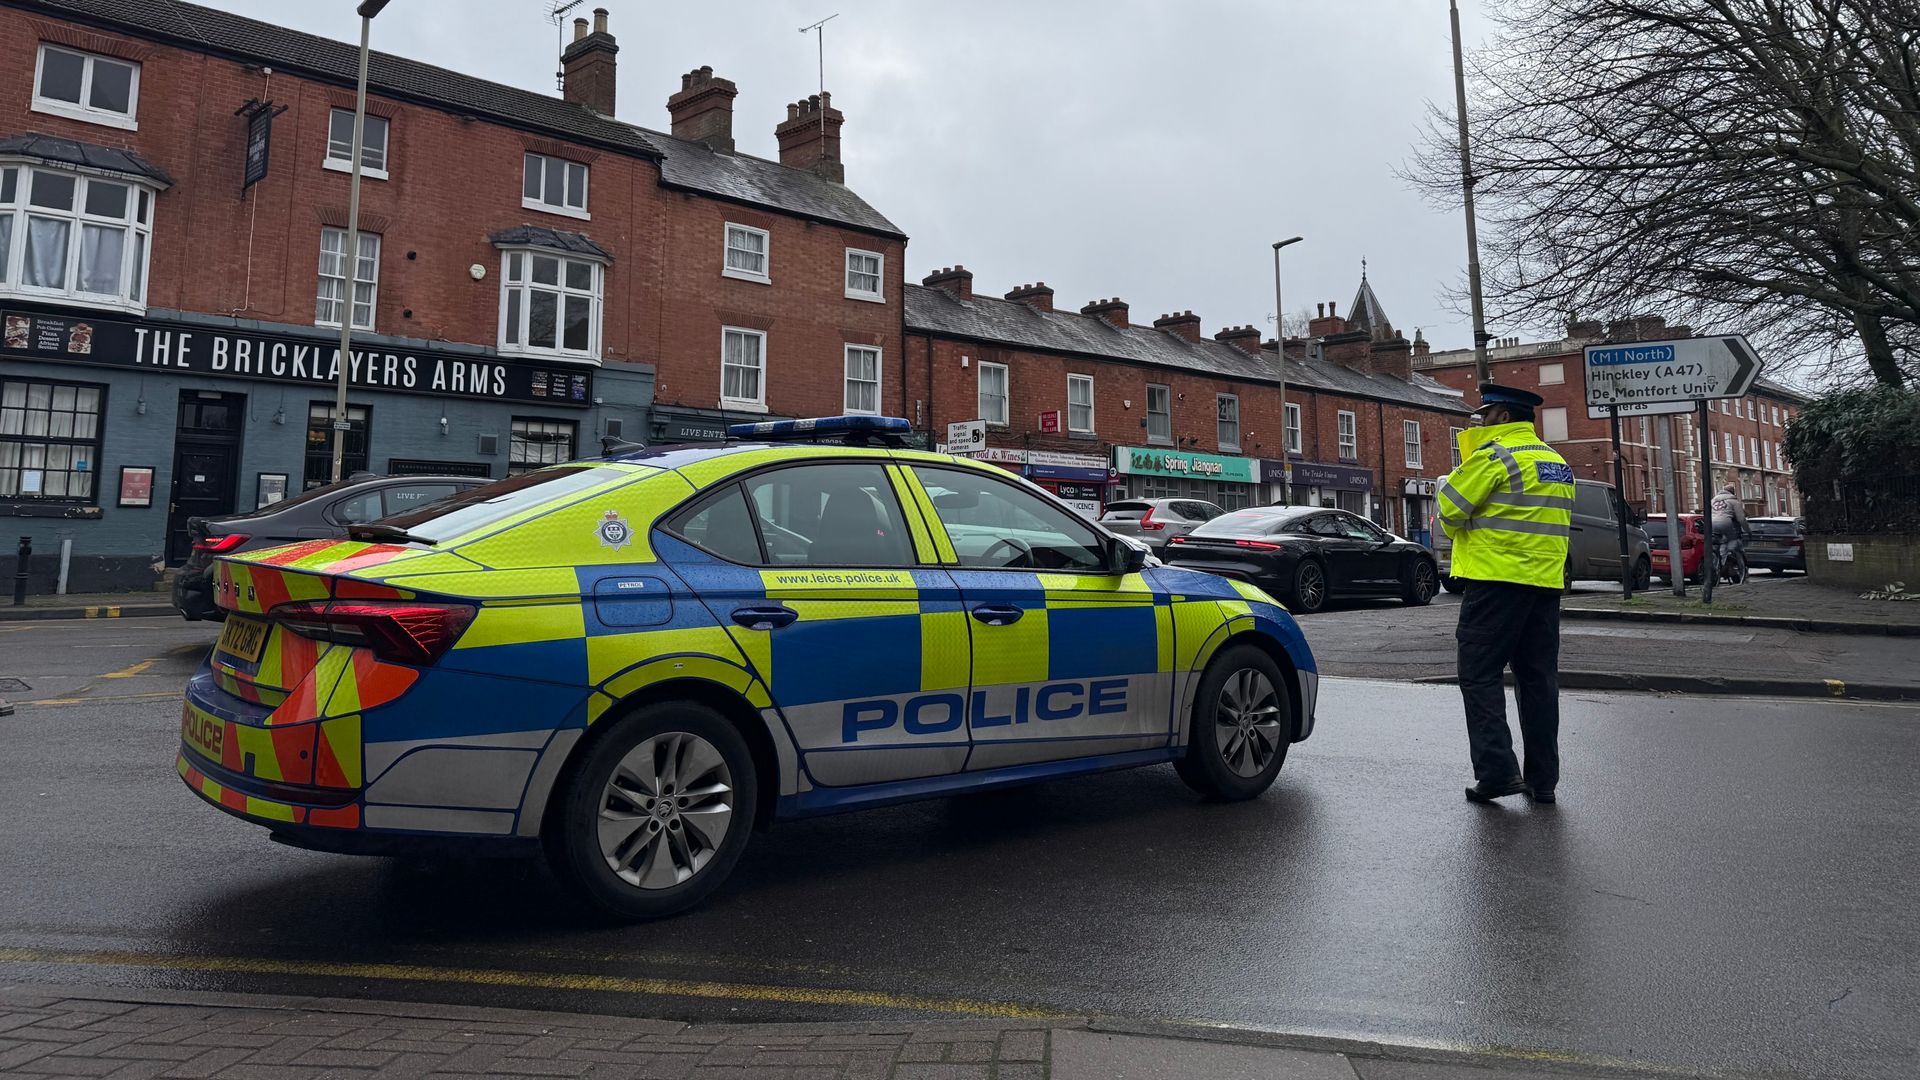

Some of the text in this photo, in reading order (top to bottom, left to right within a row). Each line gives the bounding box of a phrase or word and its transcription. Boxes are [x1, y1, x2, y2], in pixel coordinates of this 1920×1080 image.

[134, 328, 506, 395] THE BRICKLAYERS ARMS
[1591, 347, 1672, 364] (M1 North)
[1591, 362, 1703, 381] Hinckley (A47)
[1592, 389, 1610, 399] De
[1615, 384, 1678, 398] Montfort
[681, 428, 727, 439] LIVE ENTE
[958, 437, 972, 445] speed
[991, 450, 998, 460] &
[1000, 450, 1021, 462] Wines
[1164, 455, 1223, 476] Spring Jiangnan
[1268, 469, 1288, 479] UNISO
[1302, 469, 1311, 477] The
[1311, 469, 1324, 478] Trade
[1349, 476, 1368, 485] UNISON
[1060, 484, 1075, 494] Lyca
[396, 492, 415, 500] LIVE
[776, 573, 901, 585] www.leics.police.uk
[842, 678, 1129, 743] POLICE
[184, 706, 223, 754] POLICE
